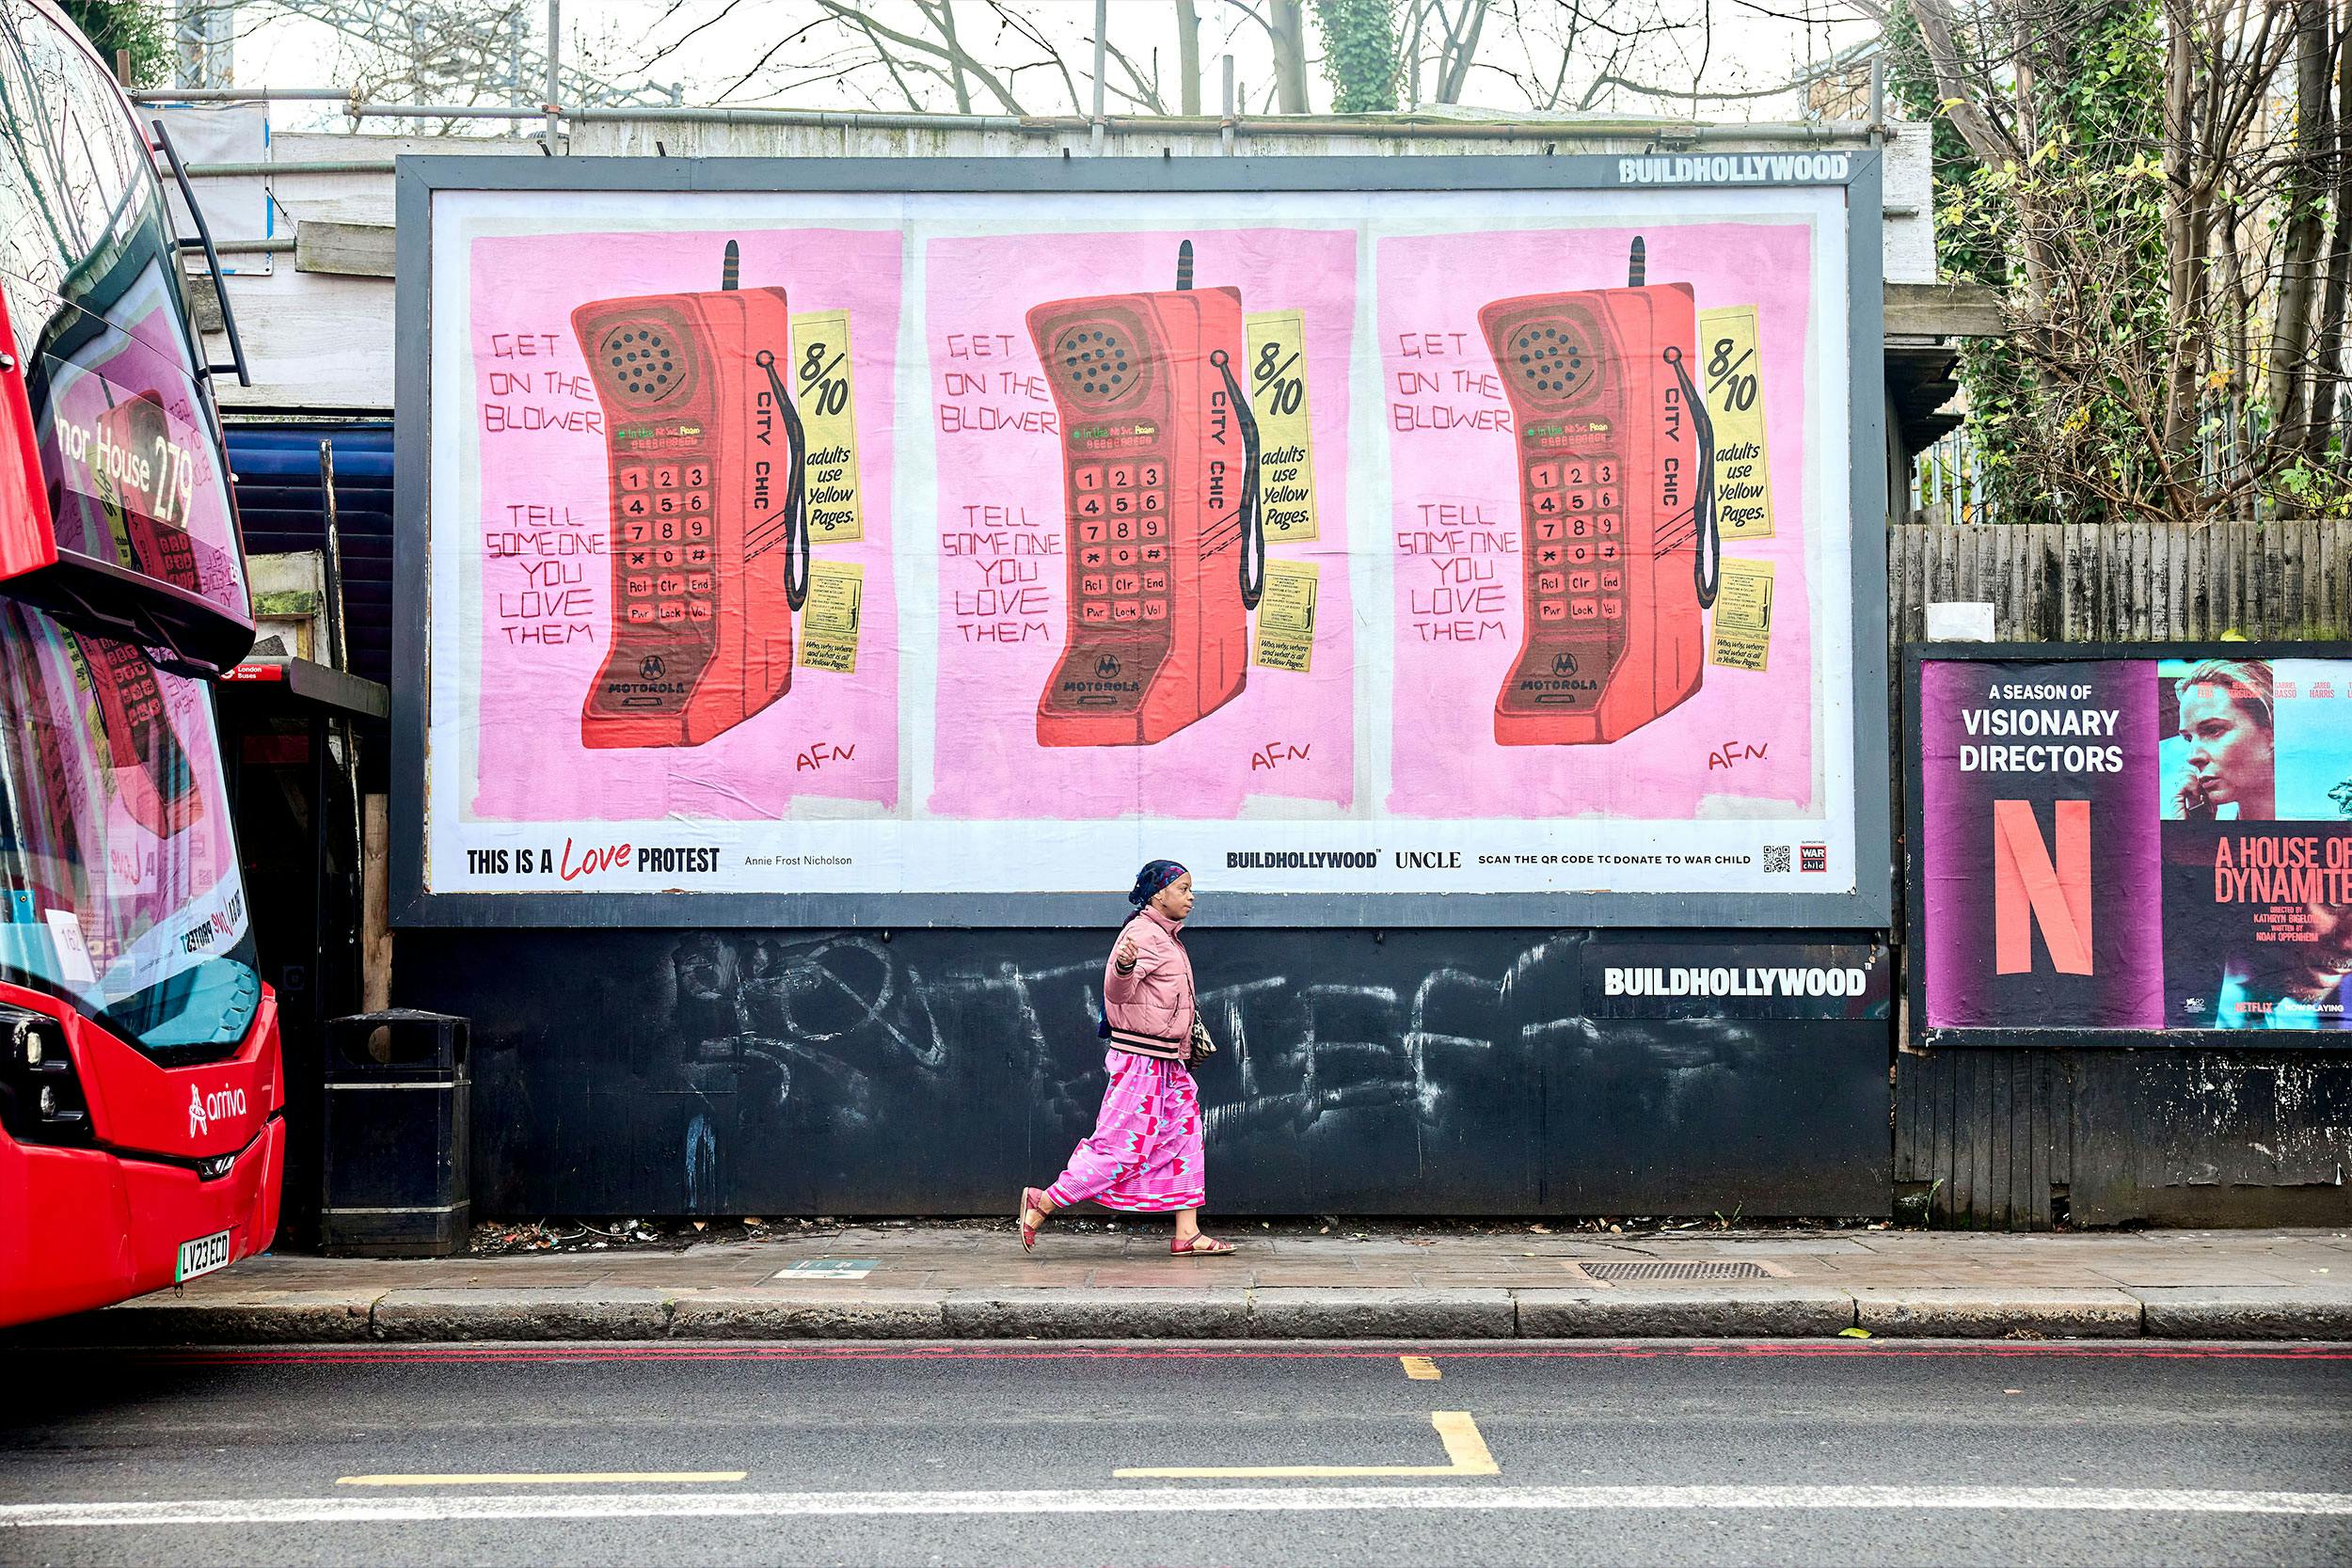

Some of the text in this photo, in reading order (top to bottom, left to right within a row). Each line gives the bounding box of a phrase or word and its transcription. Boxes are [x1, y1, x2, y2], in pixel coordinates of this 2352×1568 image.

[492, 334, 560, 359] GET
[947, 334, 1015, 359] GET
[1400, 333, 1468, 358] GET
[800, 342, 849, 416] 8/10
[1254, 342, 1303, 416] 8/10
[1397, 370, 1502, 400] ON THE
[1708, 338, 1757, 411] 8/10
[489, 372, 594, 402] ON THE
[945, 372, 1049, 402] ON THE
[485, 404, 604, 436] BLOWER
[940, 404, 1059, 436] BLOWER
[1393, 403, 1513, 435] BLOWER
[754, 391, 771, 510] CITY CHIC
[807, 445, 850, 466] adults
[1208, 390, 1226, 510] CITY CHIC
[1262, 445, 1305, 466] adults
[1662, 388, 1679, 506] CITY CHIC
[1717, 441, 1760, 462] adults
[55, 415, 193, 529] nor House 279
[818, 467, 843, 483] use
[1085, 468, 1157, 487] 1 2 3
[1272, 467, 1297, 483] use
[1727, 464, 1753, 480] use
[808, 485, 854, 506] Yellow
[1263, 484, 1310, 505] Yellow
[1718, 482, 1764, 502] Yellow
[1086, 495, 1157, 514] 4 5 6
[1418, 504, 1496, 526] TELL
[506, 505, 584, 527] TELL
[810, 508, 855, 531] Pages.
[961, 505, 1040, 527] TELL
[1265, 507, 1311, 531] Pages.
[1720, 504, 1765, 528] Pages.
[1088, 521, 1157, 540] 7 8 9
[486, 531, 606, 559] SOMEONE
[943, 531, 1062, 559] SOMEONE
[1398, 531, 1518, 558] SOMEONE
[519, 561, 582, 589] YOU
[975, 559, 1038, 587] YOU
[1431, 557, 1494, 585] YOU
[1117, 579, 1133, 592] Clr
[1147, 578, 1164, 589] End
[500, 589, 594, 618] LOVE
[955, 587, 1049, 616] LOVE
[1411, 585, 1505, 614] LOVE
[1087, 604, 1161, 618] Pwr Lock Vol
[501, 625, 594, 645] THEM
[957, 623, 1049, 643] THEM
[1413, 621, 1505, 641] THEM
[1274, 650, 1290, 659] what
[1289, 643, 1309, 653] where
[1265, 657, 1286, 667] Yellow
[608, 682, 685, 694] MOTOROLA
[1063, 680, 1140, 692] MOTOROLA
[1520, 679, 1597, 691] MOTOROLA
[1989, 684, 2092, 701] A SEASON OF
[2274, 689, 2297, 699] BASSO
[2310, 689, 2335, 699] HARRIS
[1962, 708, 2120, 736] VISIONARY
[1960, 746, 2123, 773] DIRECTORS
[467, 837, 721, 881] THIS IS A Love PROTEST
[745, 855, 852, 866] Annie Frost Nicholson
[1395, 851, 1462, 869] UNCLE
[1478, 855, 1511, 864] SCAN
[1515, 855, 1538, 864] THE
[1541, 855, 1559, 865] QR
[1562, 855, 1595, 864] CODE
[1613, 856, 1662, 864] DONATE
[1666, 856, 1681, 864] TO
[1684, 856, 1711, 864] WAR
[1714, 856, 1751, 864] CHILD
[1803, 848, 1824, 858] WAR
[2215, 836, 2352, 868] A HOUSE OF
[1803, 861, 1824, 870] child
[1994, 799, 2093, 976] N
[2215, 867, 2352, 904] DYNAMITE
[2254, 914, 2286, 923] KATHRYN
[2256, 932, 2319, 942] NOAH OPPENHEIM
[2234, 1003, 2273, 1013] NETFLIX
[2306, 1005, 2344, 1013] PLAYING
[207, 1083, 246, 1122] arriva
[183, 1233, 228, 1275] LV23 ECD
